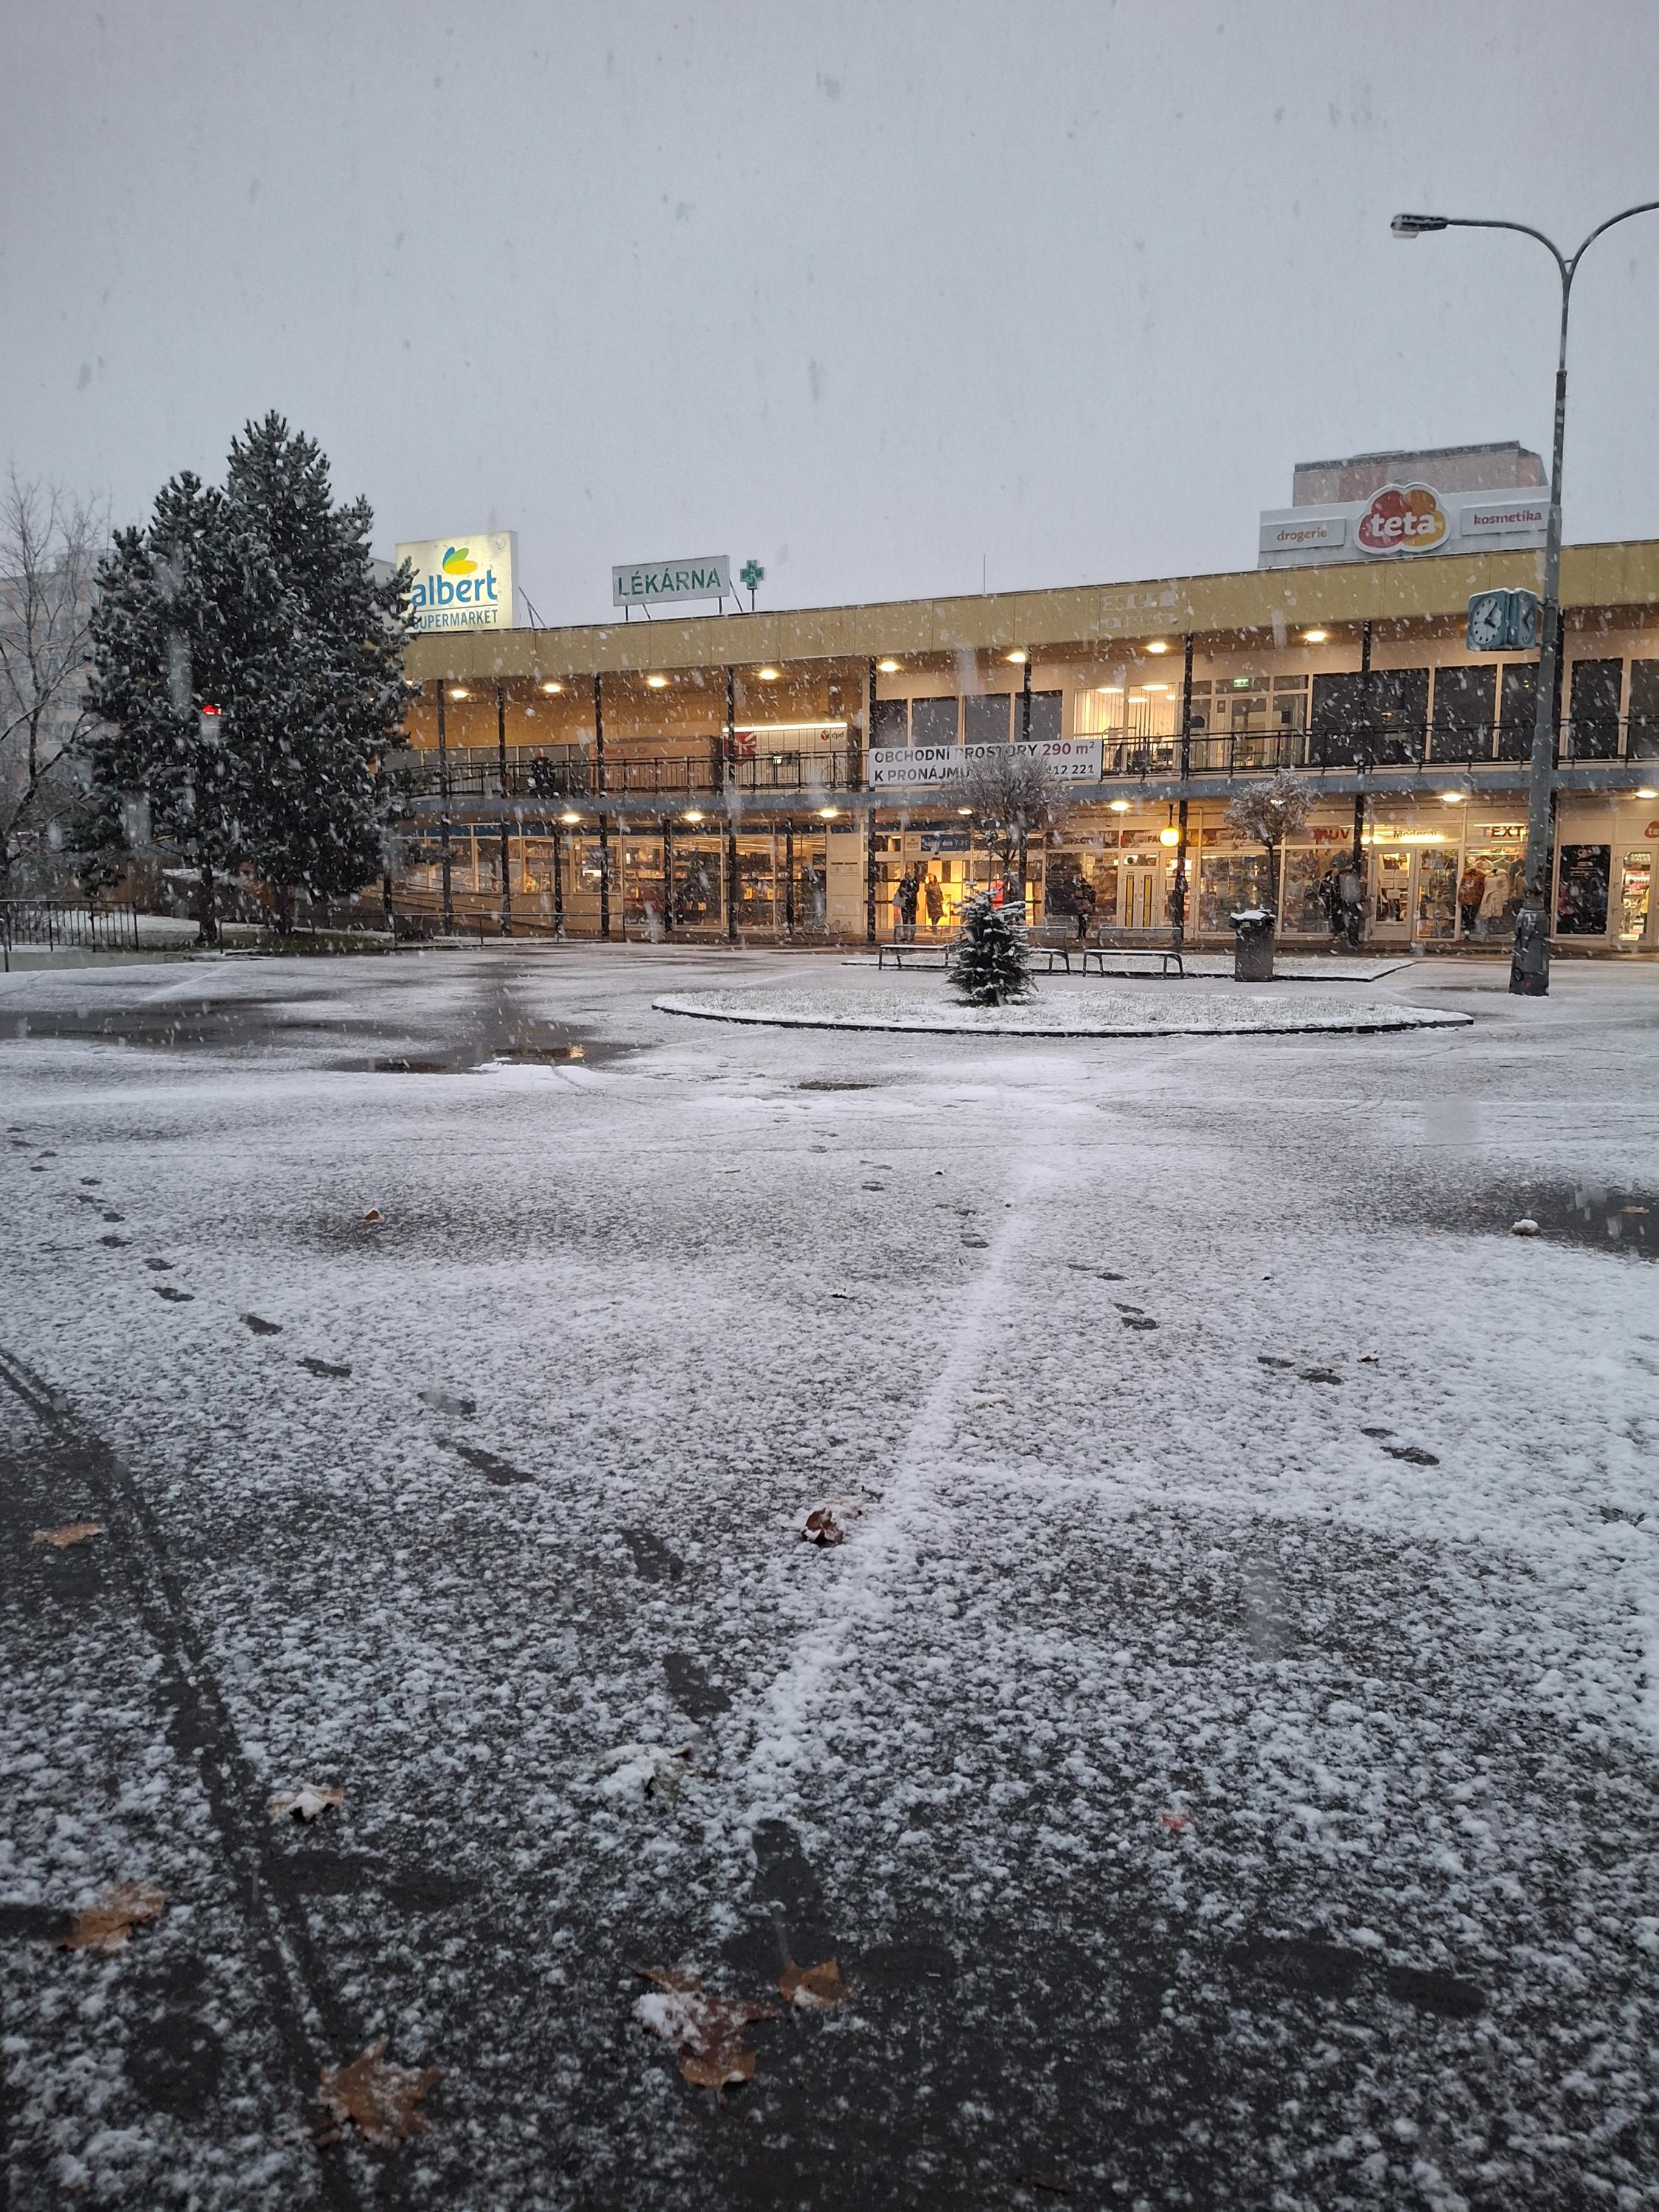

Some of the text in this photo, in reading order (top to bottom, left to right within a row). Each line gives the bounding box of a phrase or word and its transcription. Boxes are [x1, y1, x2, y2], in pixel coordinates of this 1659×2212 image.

[1371, 512, 1436, 538] teta
[1474, 509, 1542, 525] kosmetika
[1277, 527, 1327, 543] drogerie
[411, 569, 498, 606] albert
[618, 568, 721, 596] LÉKÁRNA
[832, 731, 844, 740] dpd
[874, 746, 950, 763] OBCHODNÍ
[1042, 743, 1071, 756] 290
[874, 770, 885, 782] K
[1071, 764, 1094, 774] 221
